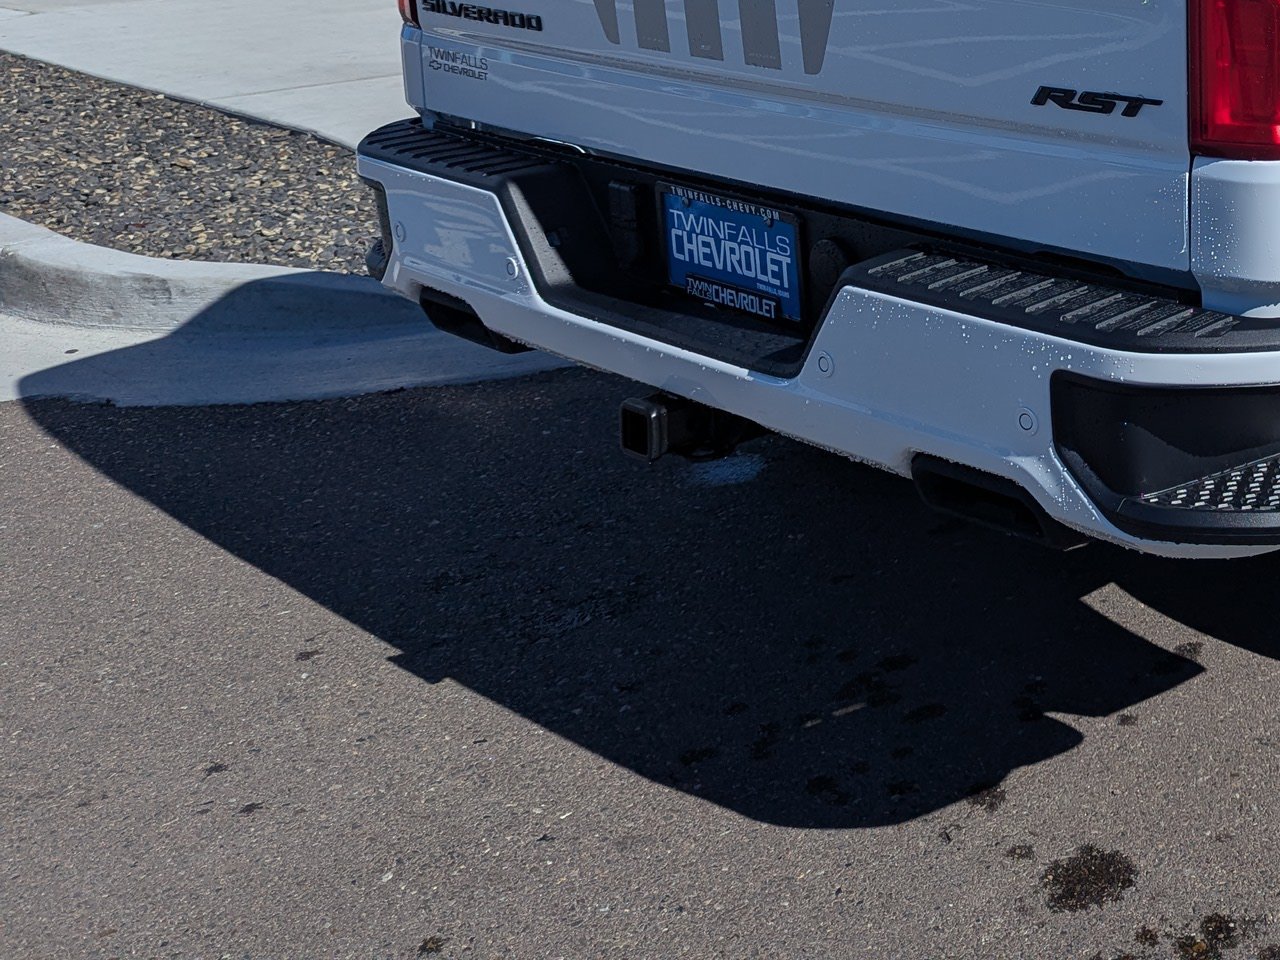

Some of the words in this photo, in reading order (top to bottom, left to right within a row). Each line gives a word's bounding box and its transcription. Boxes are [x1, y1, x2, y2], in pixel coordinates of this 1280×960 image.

[428, 46, 489, 71] TWINFALLS
[443, 63, 489, 81] CHEVROLET
[1030, 85, 1164, 118] RST
[669, 209, 791, 256] TWINFALLS
[671, 228, 791, 289] CHEVROLET
[686, 277, 713, 293] TWIN
[687, 287, 713, 301] FALLS
[713, 283, 776, 319] CHEVROLET
